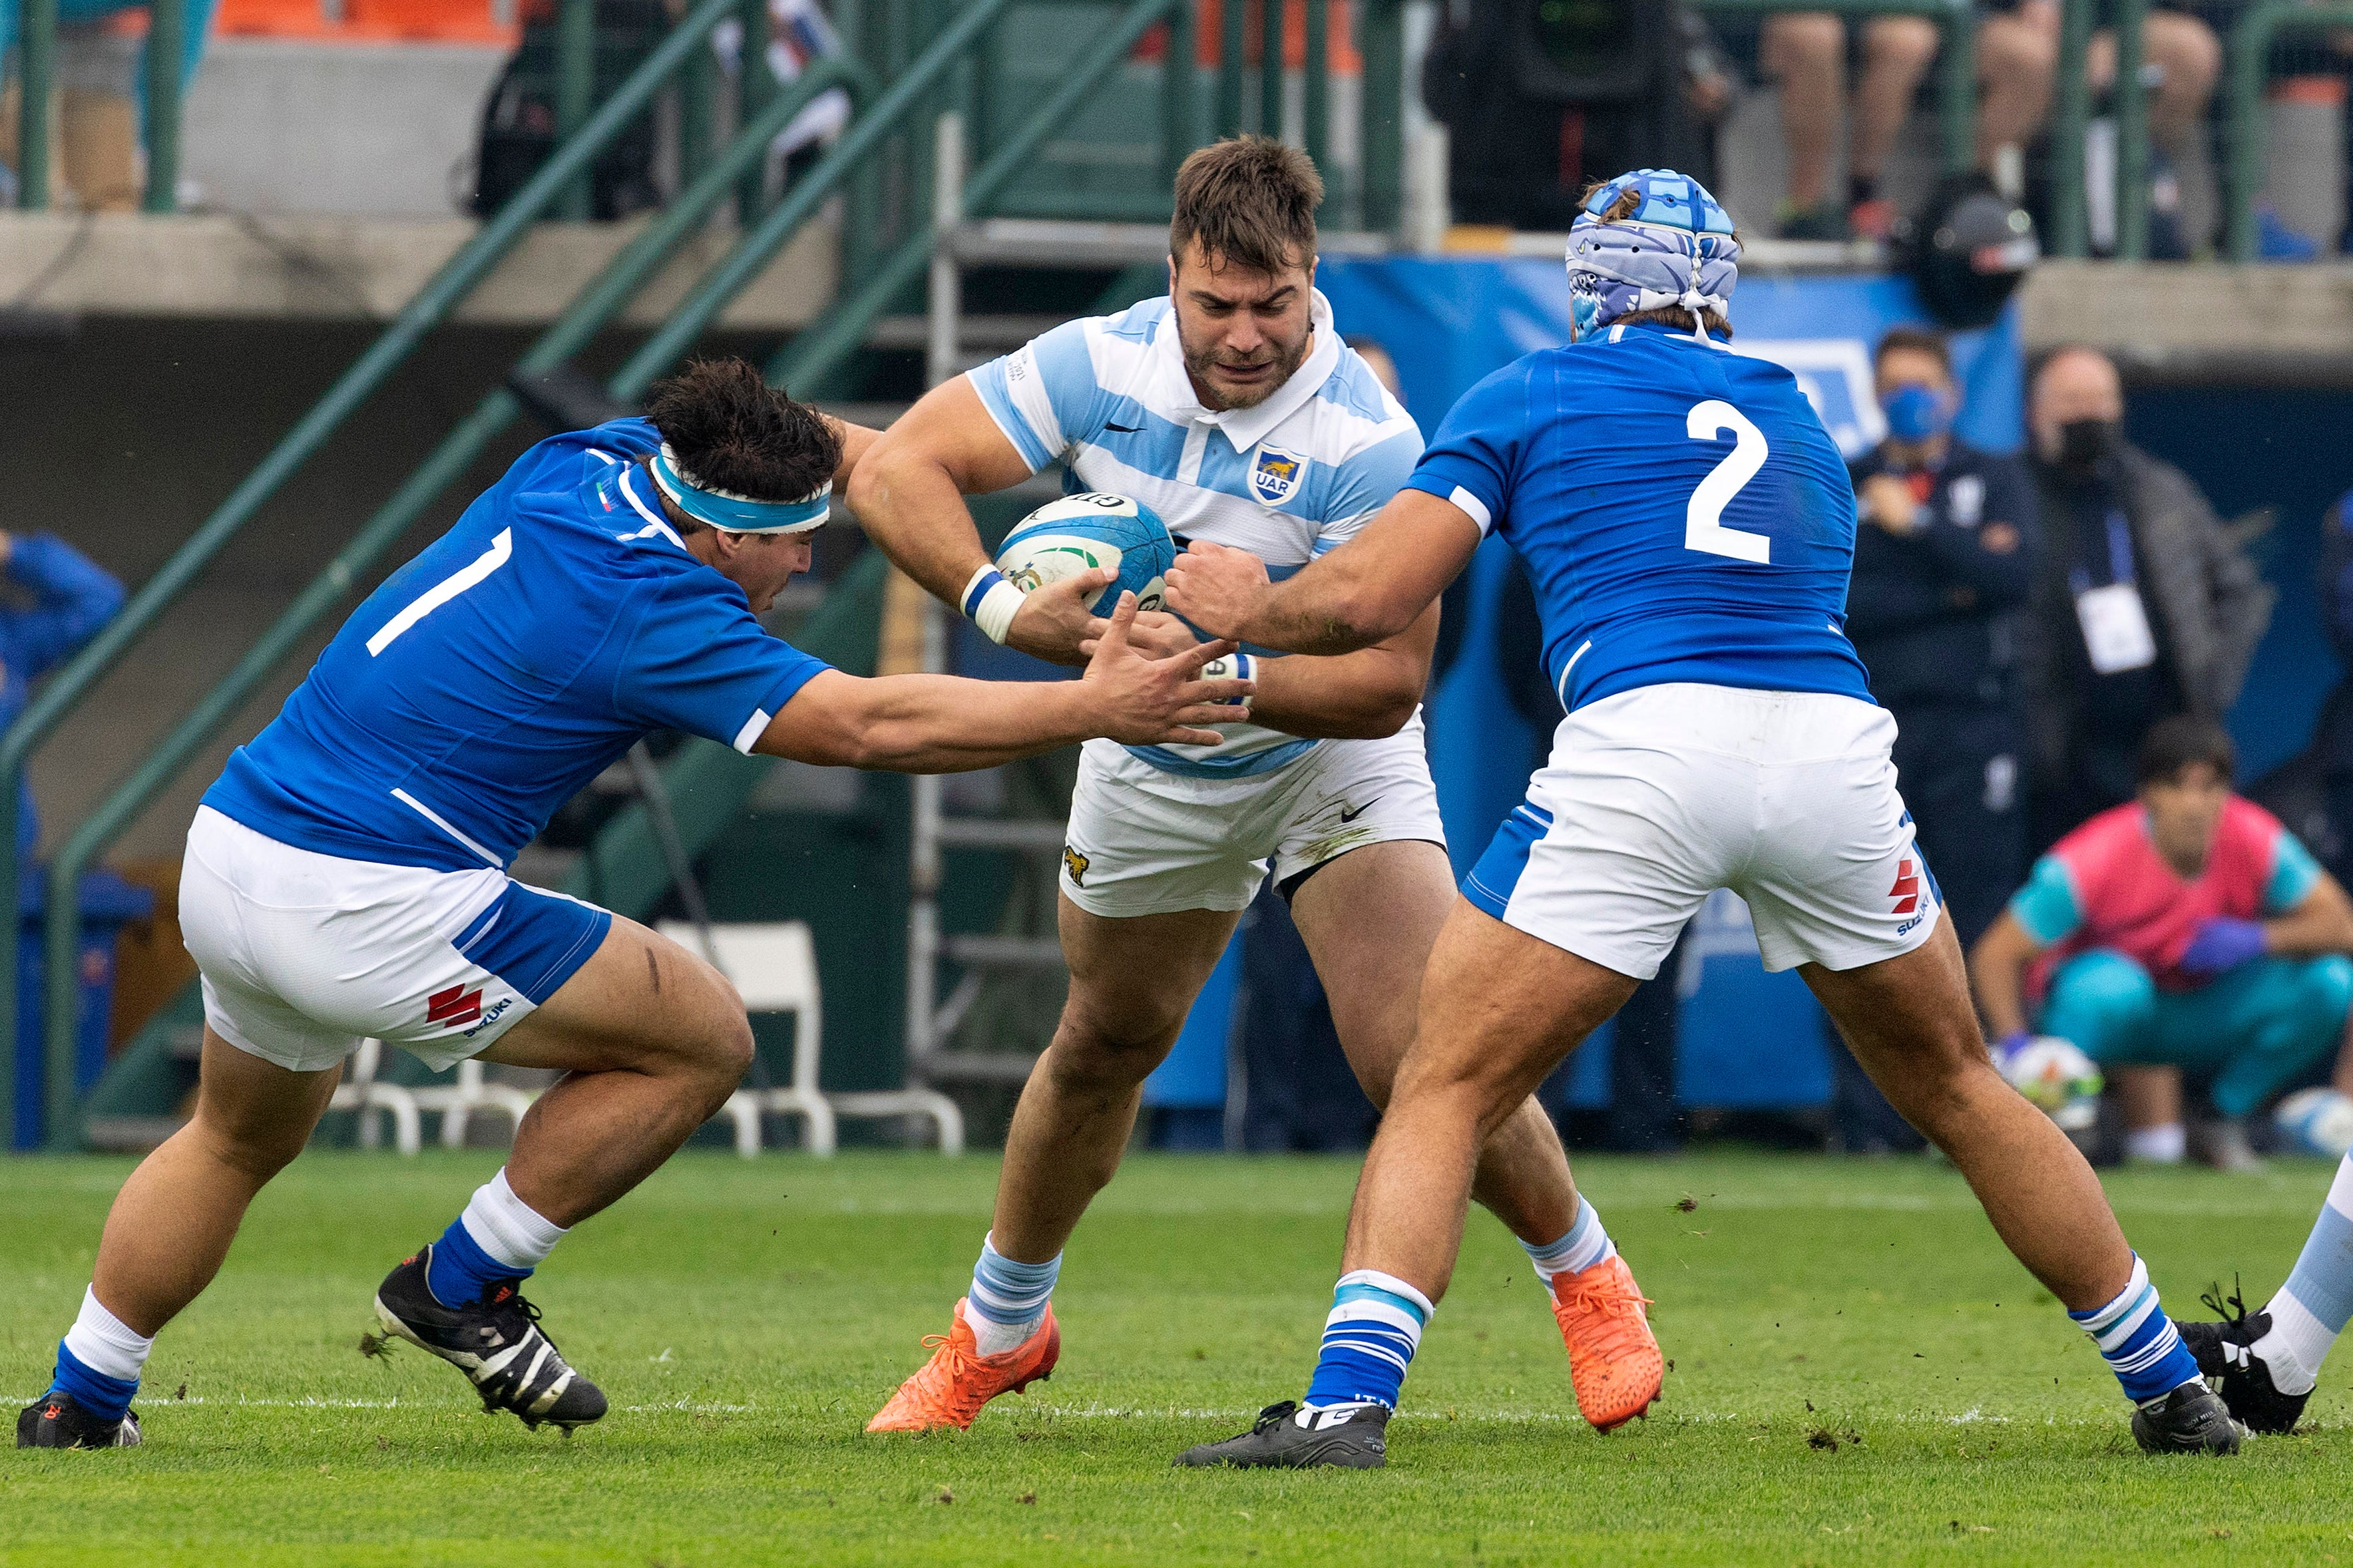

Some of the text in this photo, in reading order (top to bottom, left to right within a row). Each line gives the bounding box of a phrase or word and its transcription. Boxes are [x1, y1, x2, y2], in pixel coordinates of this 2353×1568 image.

[1256, 473, 1289, 494] UAR
[1685, 399, 1771, 564] 2
[365, 526, 513, 656] 1
[1896, 895, 1930, 936] SUZUKI
[463, 998, 513, 1038] SUZUKI
